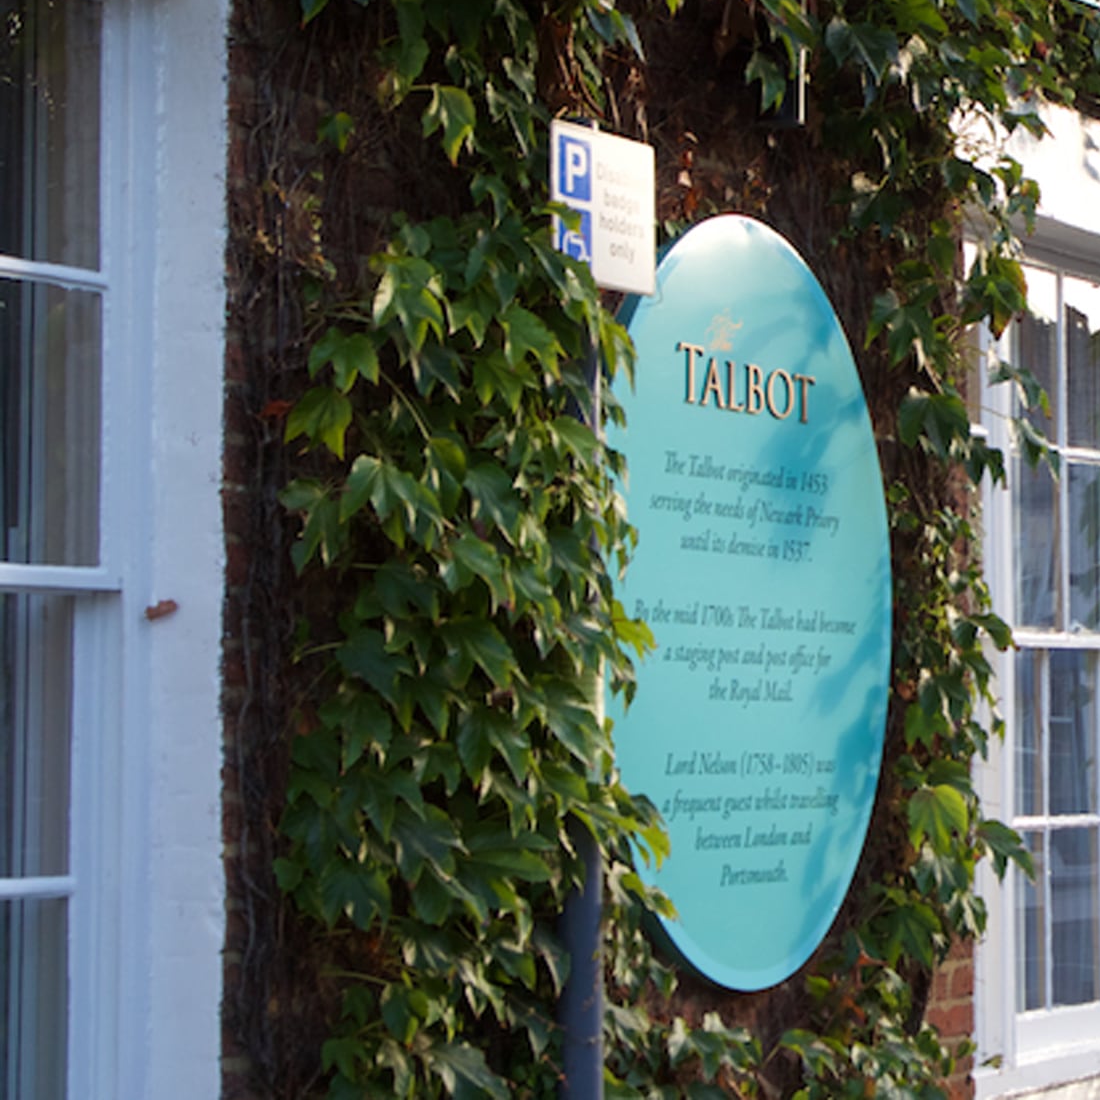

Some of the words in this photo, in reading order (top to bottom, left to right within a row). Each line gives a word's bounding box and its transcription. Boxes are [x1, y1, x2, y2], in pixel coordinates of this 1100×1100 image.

[565, 141, 588, 193] P
[609, 241, 635, 265] only
[675, 341, 816, 425] TALBOT
[664, 450, 685, 475] The
[687, 453, 725, 481] Talbot
[727, 462, 783, 492] originated
[785, 466, 798, 491] in
[648, 491, 692, 522] serving
[693, 492, 712, 515] the
[713, 495, 745, 519] needs
[746, 498, 762, 529] of
[803, 504, 840, 538] Priory
[680, 528, 710, 552] until
[711, 532, 726, 555] its
[727, 532, 766, 557] demise
[766, 536, 779, 560] in
[651, 598, 672, 624] the
[673, 599, 699, 626] mid
[737, 605, 757, 629] The
[759, 606, 795, 632] Talbot
[796, 608, 818, 633] had
[819, 609, 857, 636] become
[663, 646, 672, 662] a
[673, 641, 716, 672] staging
[716, 646, 740, 672] post
[741, 641, 766, 666] and
[765, 650, 788, 674] post
[788, 644, 816, 675] office
[814, 645, 832, 675] for
[708, 677, 728, 701] the
[728, 678, 762, 709] Royal
[664, 750, 698, 776] Lord
[698, 750, 737, 776] Nelson
[815, 758, 837, 774] was
[669, 787, 722, 823] frequent
[722, 794, 754, 820] guest
[754, 786, 788, 811] whilst
[694, 825, 742, 851] between
[743, 823, 789, 848] London
[789, 821, 814, 846] and
